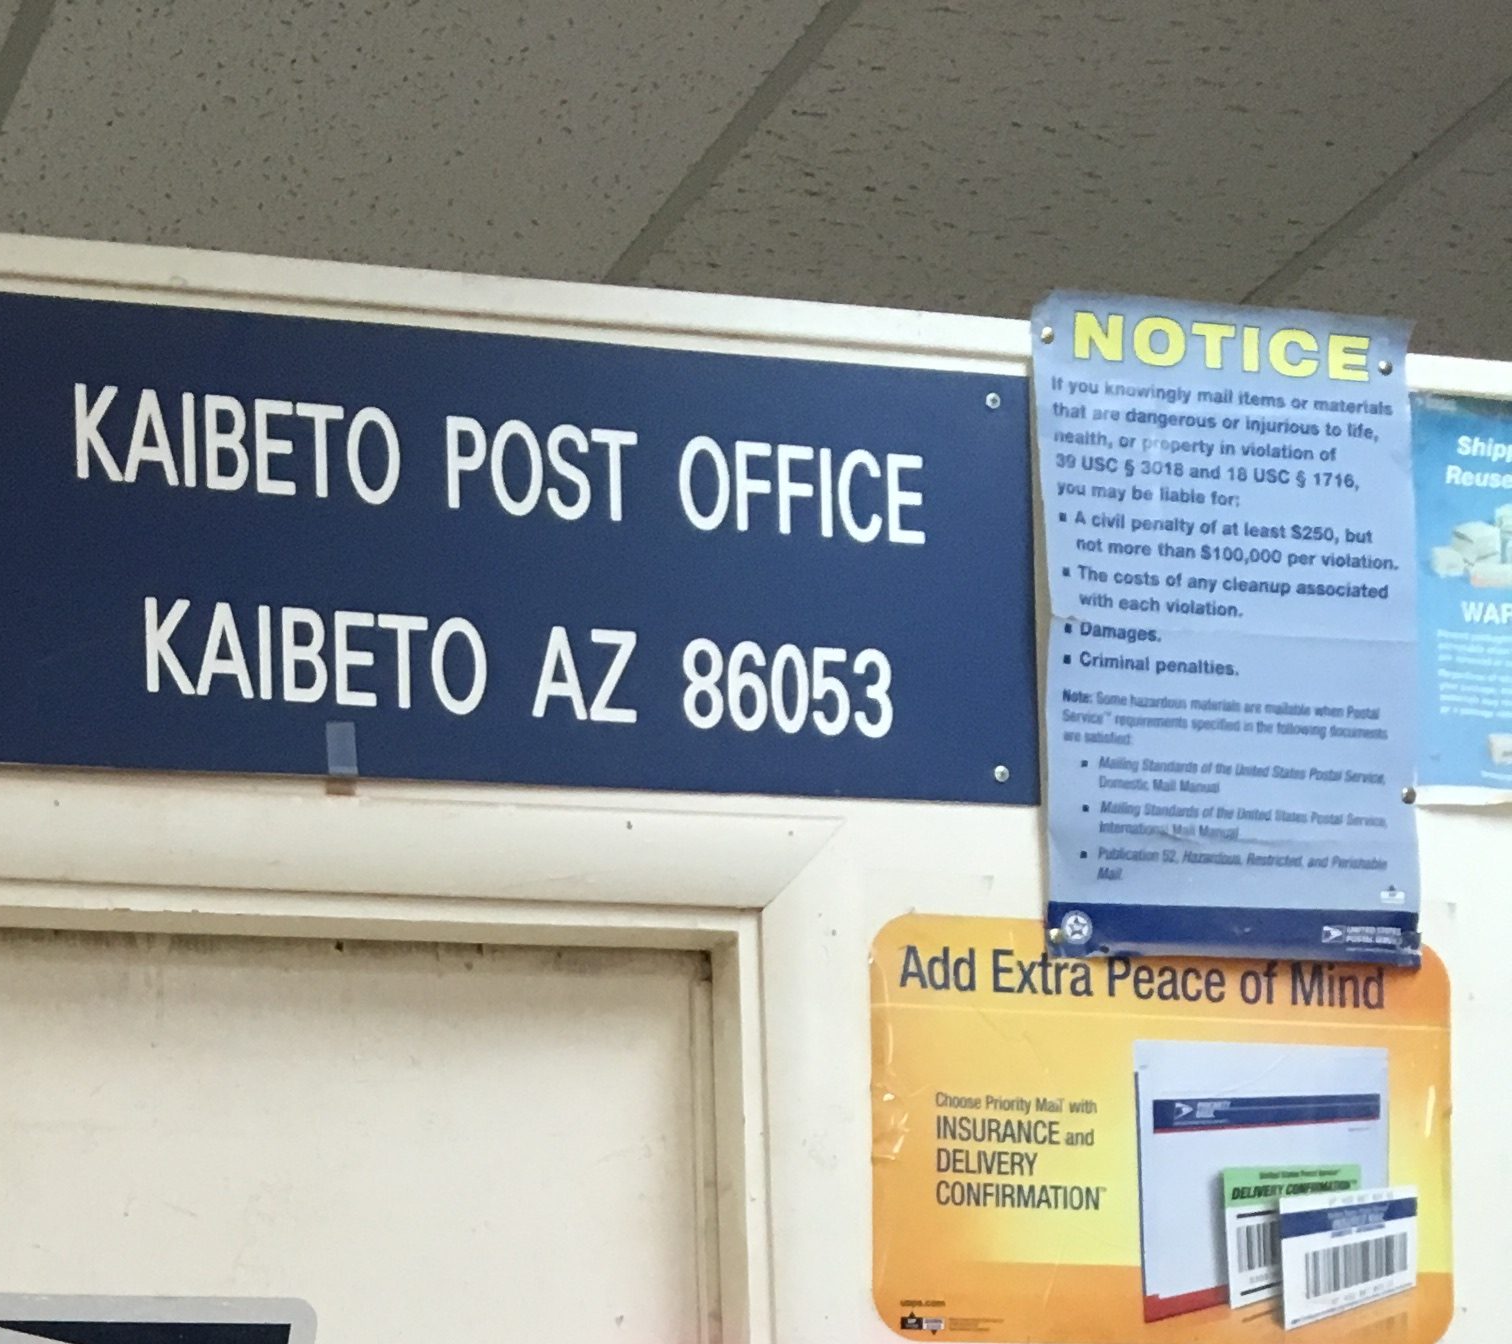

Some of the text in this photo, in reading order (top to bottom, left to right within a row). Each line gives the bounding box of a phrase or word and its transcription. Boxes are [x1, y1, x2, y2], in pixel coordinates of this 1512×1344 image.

[1073, 311, 1371, 382] NOTICE
[1051, 376, 1394, 416] If you knowingly mail items or materials
[74, 383, 926, 545] KAIBETO POST OFFICE
[1074, 510, 1373, 545] A civil penalty of at least $250, but
[1076, 537, 1400, 570] not more than $100,000 per violation.
[1080, 621, 1162, 644] Damages.
[144, 597, 894, 738] KAIBETO AZ 86053
[1079, 650, 1240, 677] Criminal penalties.
[900, 945, 1387, 1010] Add Extra Peace of Mind
[936, 1091, 981, 1109] Choose
[986, 1095, 1031, 1115] Priority
[1069, 1099, 1097, 1113] with
[936, 1115, 1095, 1146] INSURANCE and
[936, 1148, 1038, 1176] DELIVERY
